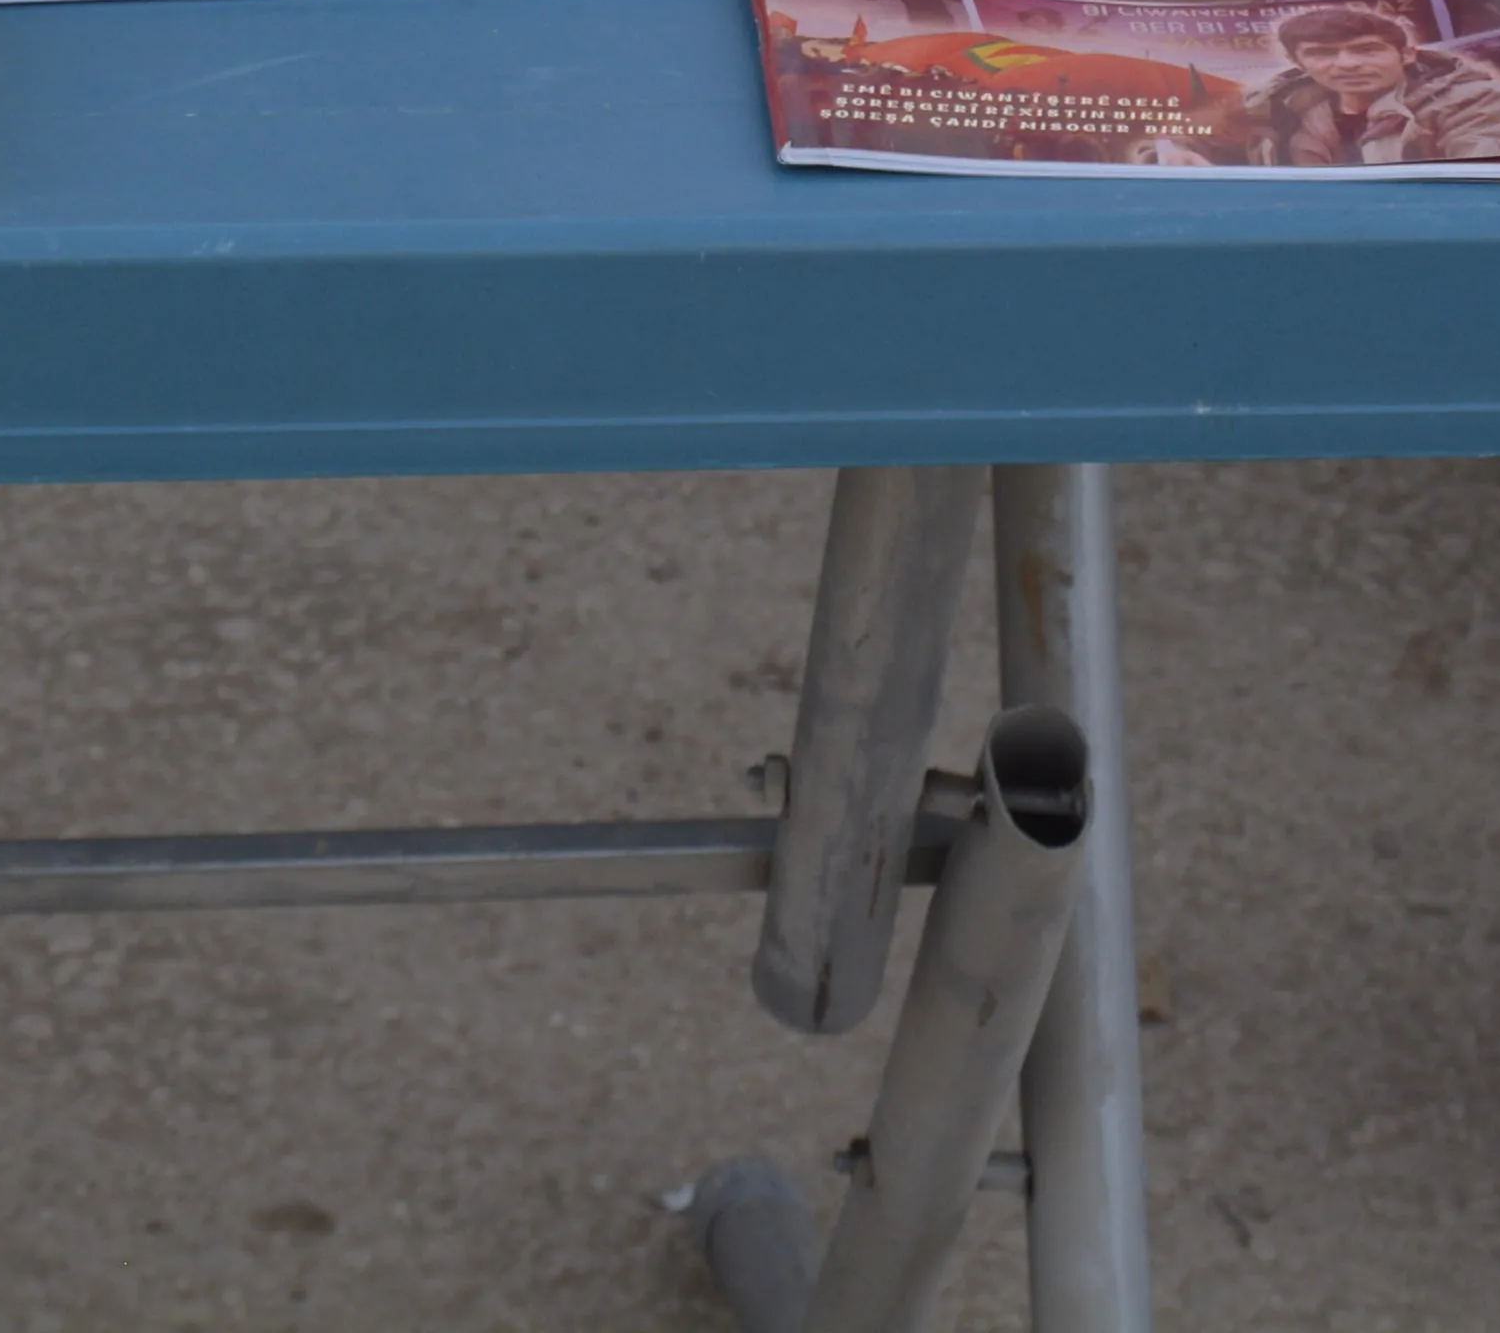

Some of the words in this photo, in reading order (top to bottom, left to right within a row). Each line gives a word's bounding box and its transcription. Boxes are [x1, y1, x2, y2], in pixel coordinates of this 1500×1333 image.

[841, 82, 893, 97] EMÊ
[899, 86, 924, 97] BI
[929, 88, 1041, 106] CIWANTÎ
[1117, 94, 1180, 109] GELÊ
[984, 102, 1106, 121] RÊXISTIN
[1018, 120, 1132, 135] MISOGER
